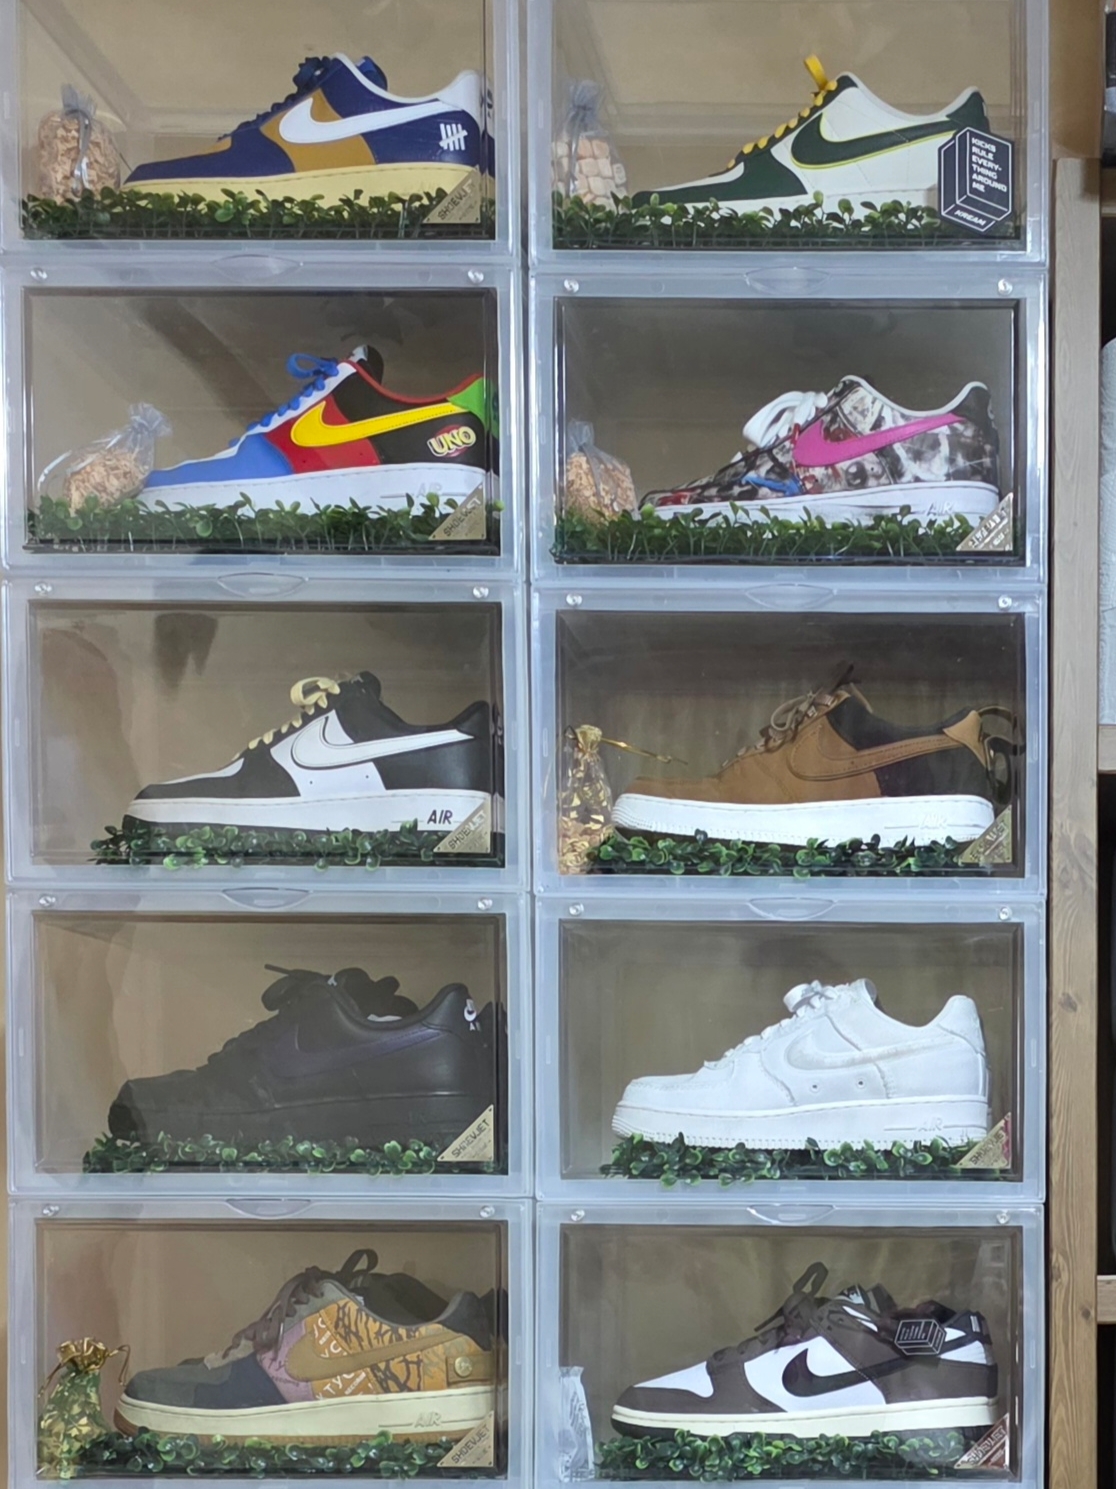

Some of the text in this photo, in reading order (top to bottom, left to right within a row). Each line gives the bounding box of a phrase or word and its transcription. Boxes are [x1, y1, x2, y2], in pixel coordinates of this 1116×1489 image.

[972, 146, 994, 160] RULE
[427, 426, 476, 456] UNO
[427, 810, 453, 824] AIR
[414, 1412, 441, 1428] AIR
[450, 1424, 491, 1464] SHOEVJET
